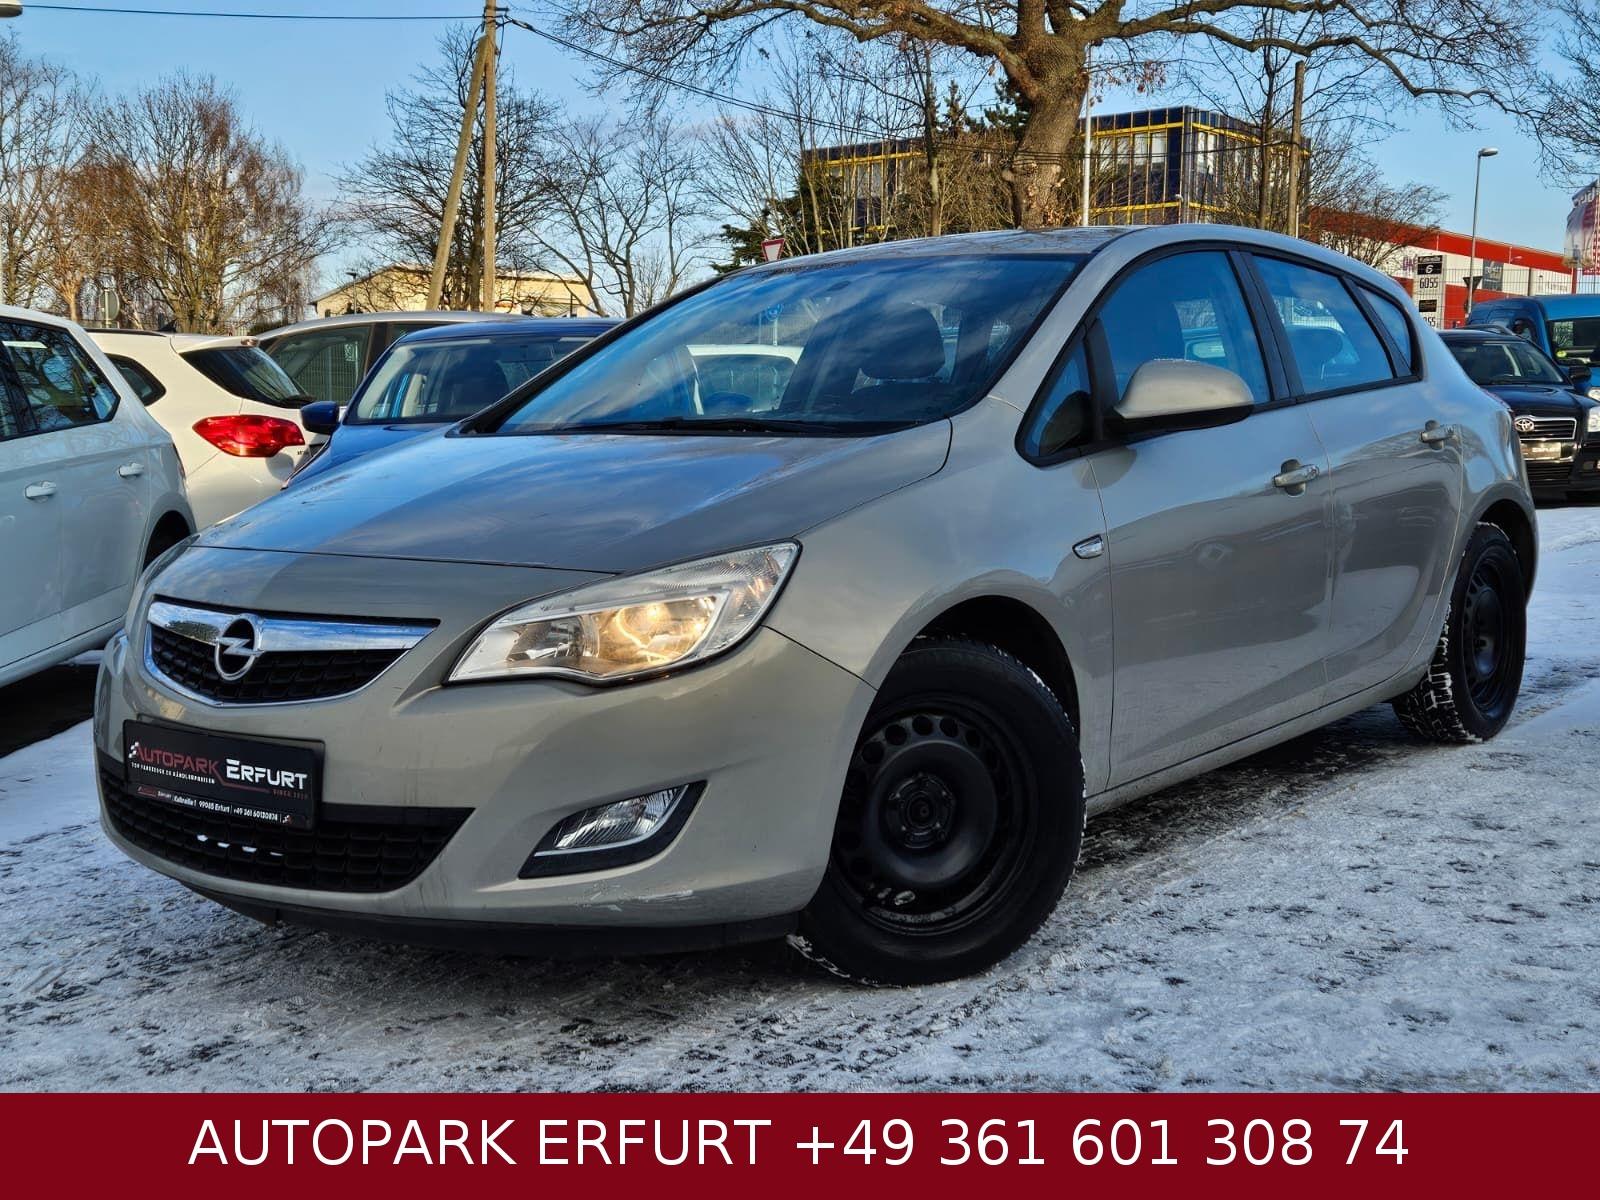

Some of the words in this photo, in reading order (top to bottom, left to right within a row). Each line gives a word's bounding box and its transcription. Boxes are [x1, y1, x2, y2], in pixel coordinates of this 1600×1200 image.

[1425, 264, 1434, 274] 6
[1419, 277, 1438, 289] 6055
[128, 741, 219, 775] AUTOPARK
[225, 758, 308, 790] ERFURT
[214, 803, 230, 813] Erfurt
[243, 808, 253, 817] 361
